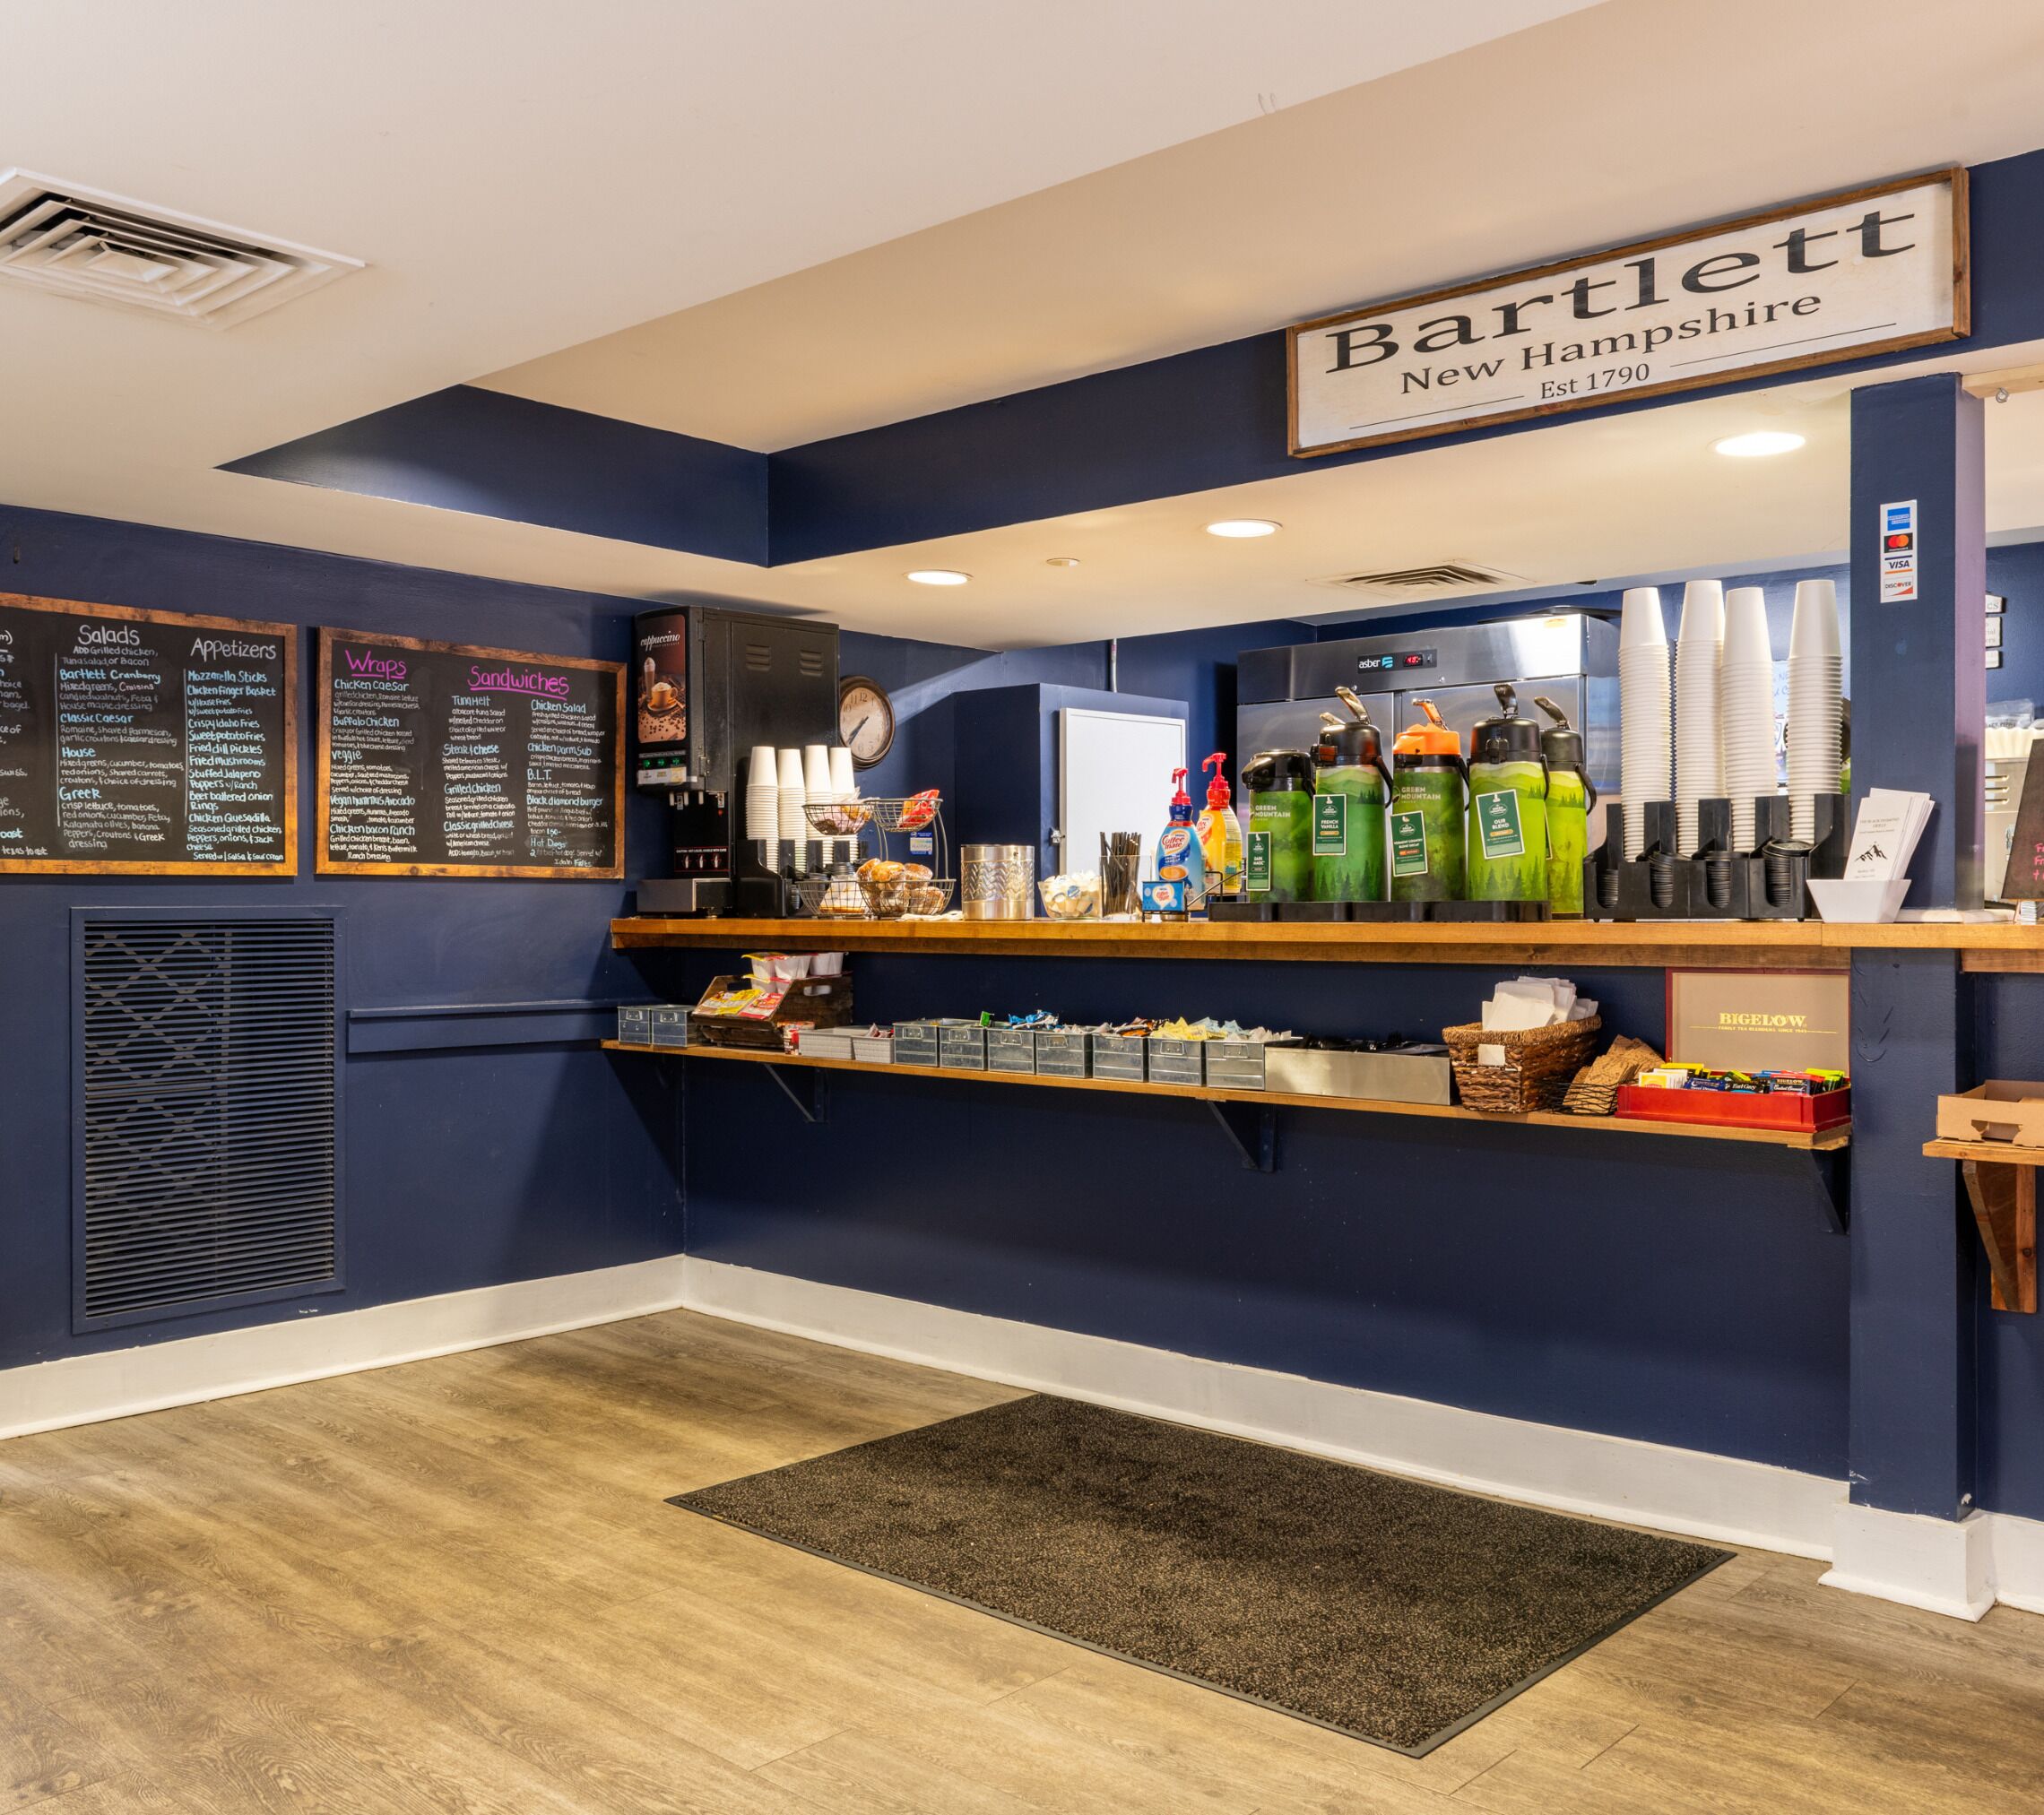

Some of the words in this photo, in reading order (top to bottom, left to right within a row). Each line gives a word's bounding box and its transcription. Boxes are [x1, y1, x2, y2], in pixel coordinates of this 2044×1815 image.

[1326, 212, 1915, 374] Bartlett
[1401, 359, 1506, 394] New
[1521, 296, 1822, 371] Hampshire
[1540, 378, 1578, 399] Est
[1588, 363, 1650, 392] 1790
[1889, 560, 1910, 569] VISA
[1884, 581, 1912, 589] DISCOVER
[78, 625, 140, 644] Salads
[640, 630, 681, 652] cappuccino
[190, 637, 277, 662] Appetizers
[120, 657, 150, 666] Bacon
[345, 649, 407, 681] Wraps
[1358, 659, 1381, 669] asber
[60, 669, 107, 680] Bartlett
[188, 670, 236, 682] Mozzarella
[238, 670, 268, 682] Sticks
[467, 665, 570, 696] Sandwiches
[333, 678, 371, 690] Chicken
[246, 686, 276, 696] Basket
[451, 696, 472, 706] Tuna
[859, 692, 868, 703] 12
[531, 699, 562, 712] Chicken
[562, 703, 586, 714] Salad
[60, 713, 95, 722] Classic
[333, 716, 366, 727] Buffalo
[366, 716, 400, 728] Chicken
[188, 718, 215, 730] Crispy
[216, 718, 238, 728] Idaho
[240, 718, 260, 728] Fries
[246, 731, 266, 741] Fries
[62, 747, 96, 758] House
[189, 742, 212, 754] Fried
[212, 742, 229, 755] dill
[442, 743, 469, 756] Steak
[576, 746, 593, 756] Sub
[189, 754, 214, 766] Fried
[188, 768, 223, 779] Stuffed
[526, 768, 552, 781] B.L.T.
[59, 787, 102, 800] Greek
[444, 782, 472, 795] Grilled
[526, 794, 548, 806] Black
[189, 800, 220, 814] Rings
[188, 813, 223, 823] Chicken
[329, 824, 366, 834] Chicken
[365, 825, 389, 834] bacon
[444, 820, 472, 832] Classic
[472, 820, 493, 833] grilled
[68, 839, 108, 849] dressing
[530, 837, 545, 847] Hot
[1719, 1013, 1807, 1027] BIGELOW
